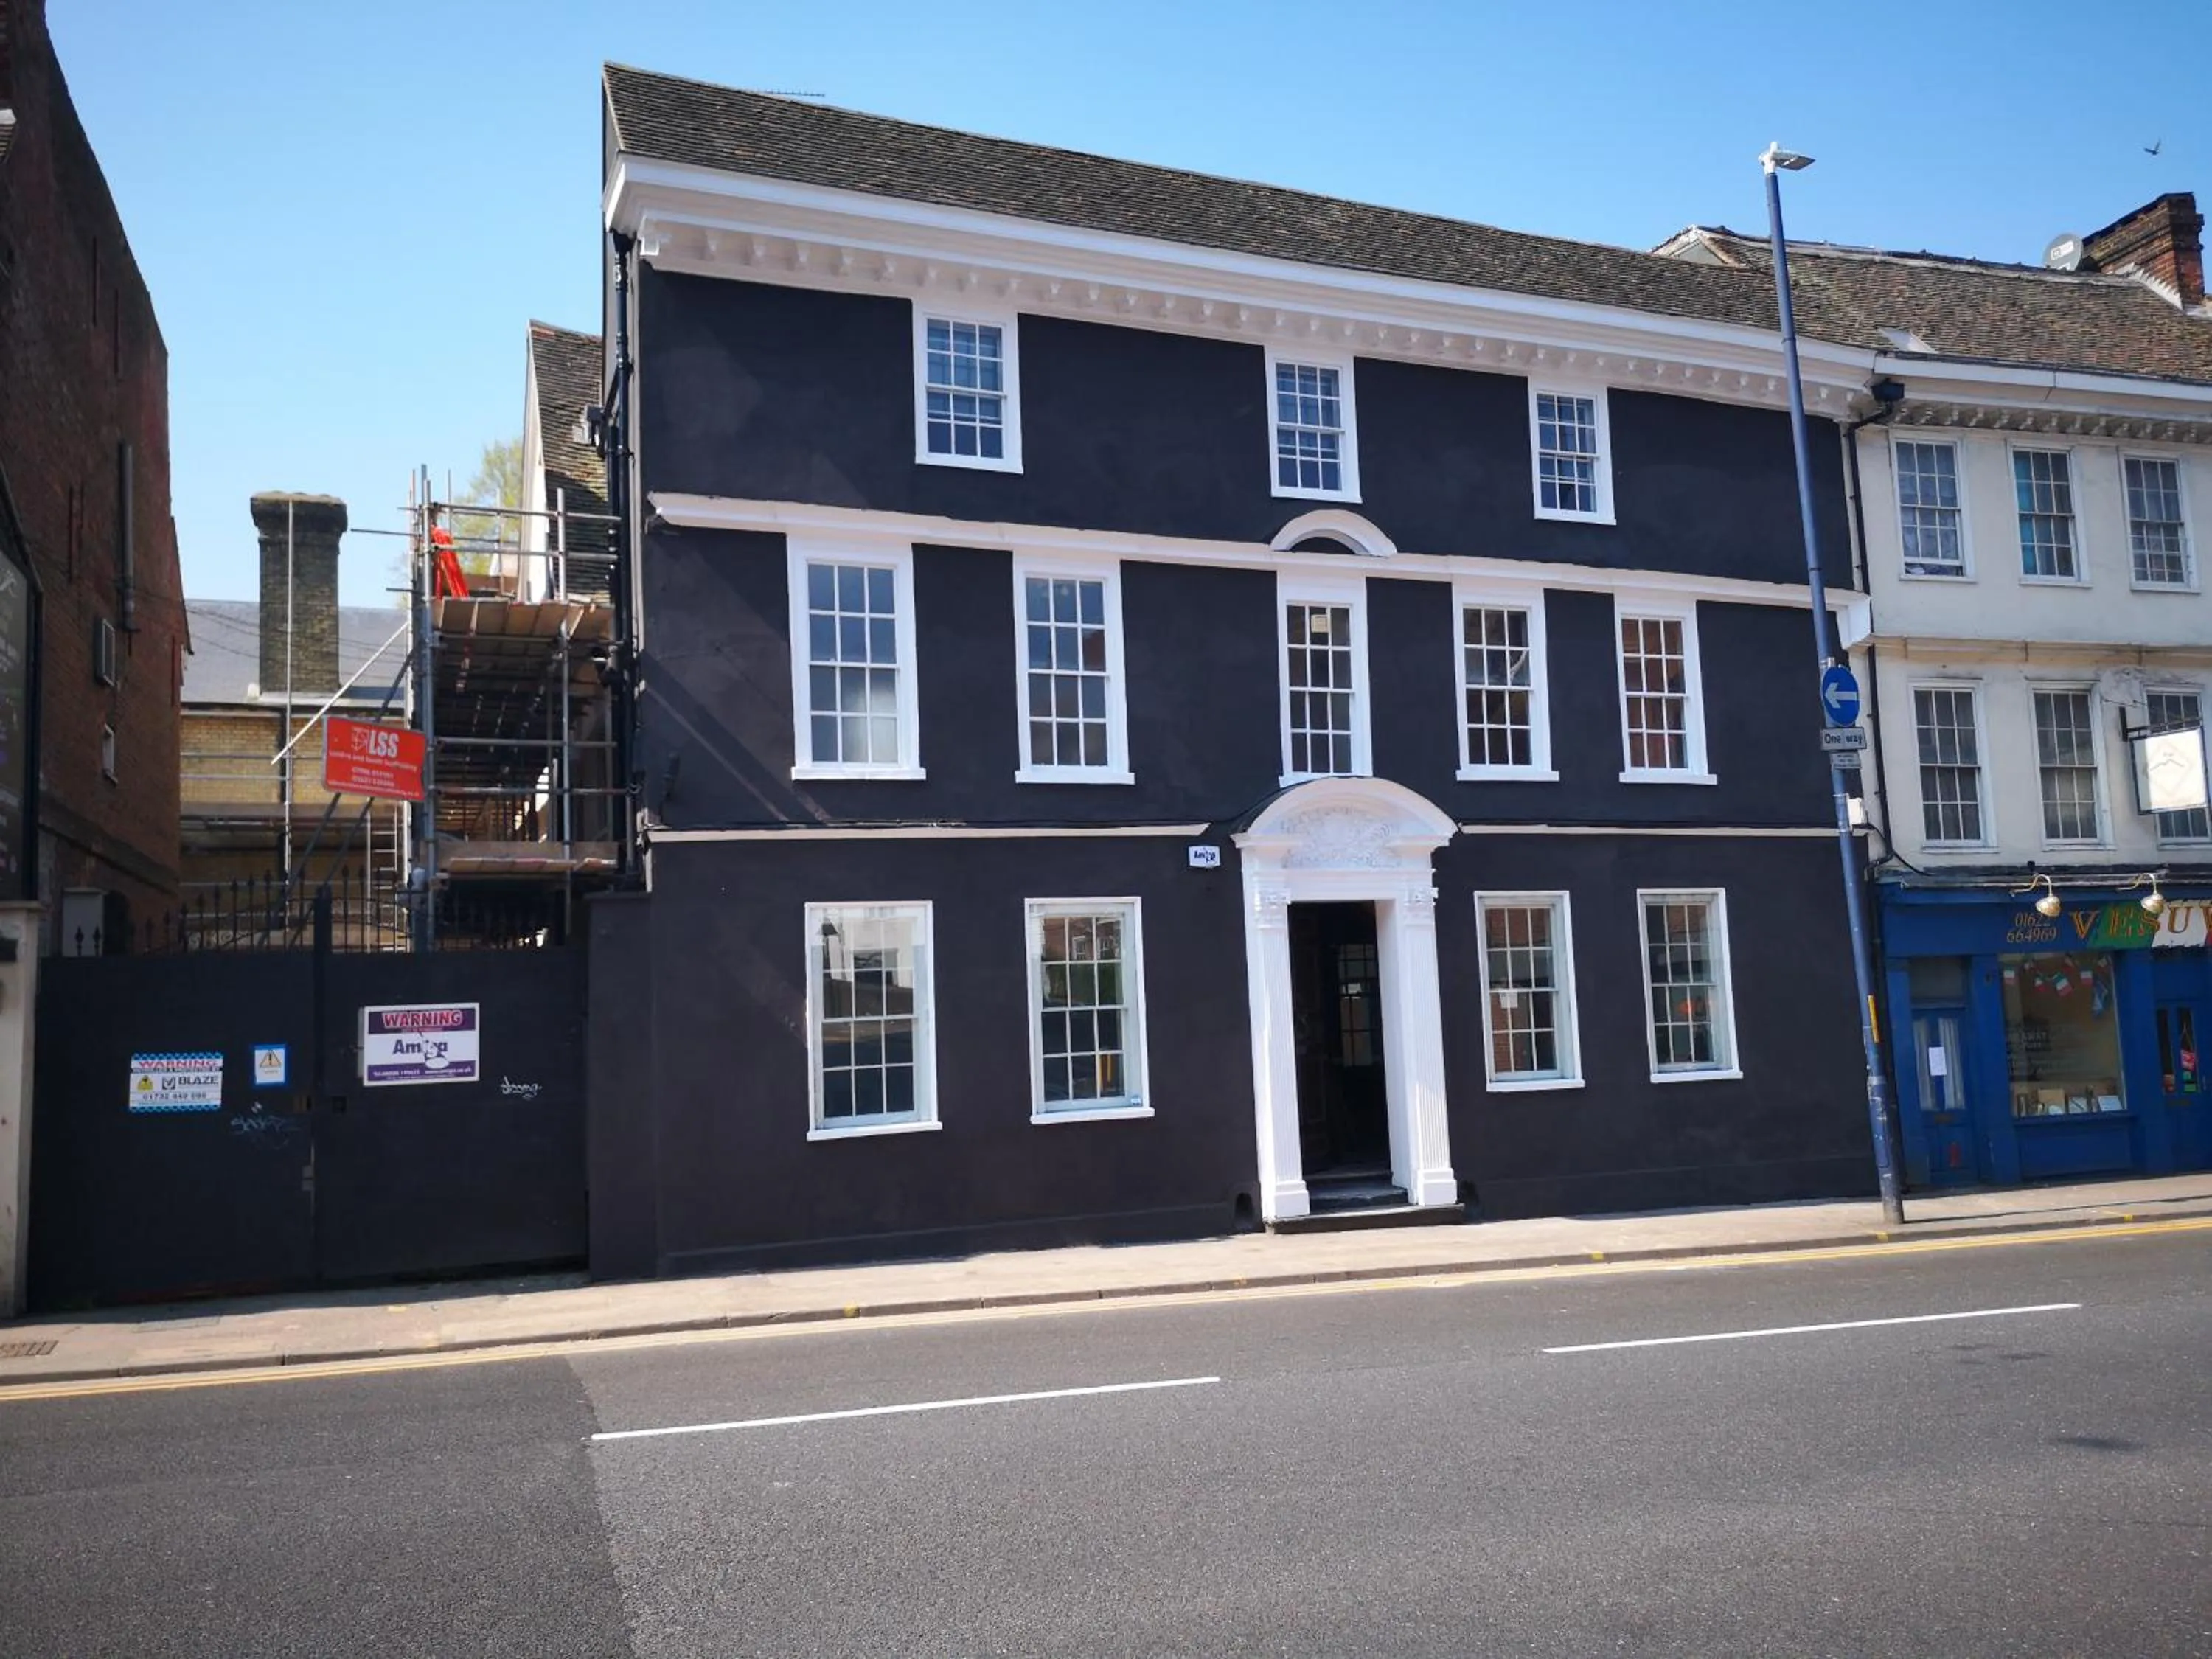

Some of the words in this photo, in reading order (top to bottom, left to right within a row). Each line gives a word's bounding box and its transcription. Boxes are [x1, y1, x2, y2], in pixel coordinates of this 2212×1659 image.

[369, 730, 399, 758] LSS
[1824, 734, 1841, 743] One
[1846, 735, 1863, 745] way
[2006, 927, 2057, 944] 664969
[383, 1010, 463, 1029] WARNING
[392, 1039, 448, 1054] Ama
[138, 1060, 217, 1069] WARNING
[178, 1076, 219, 1085] BLAZE
